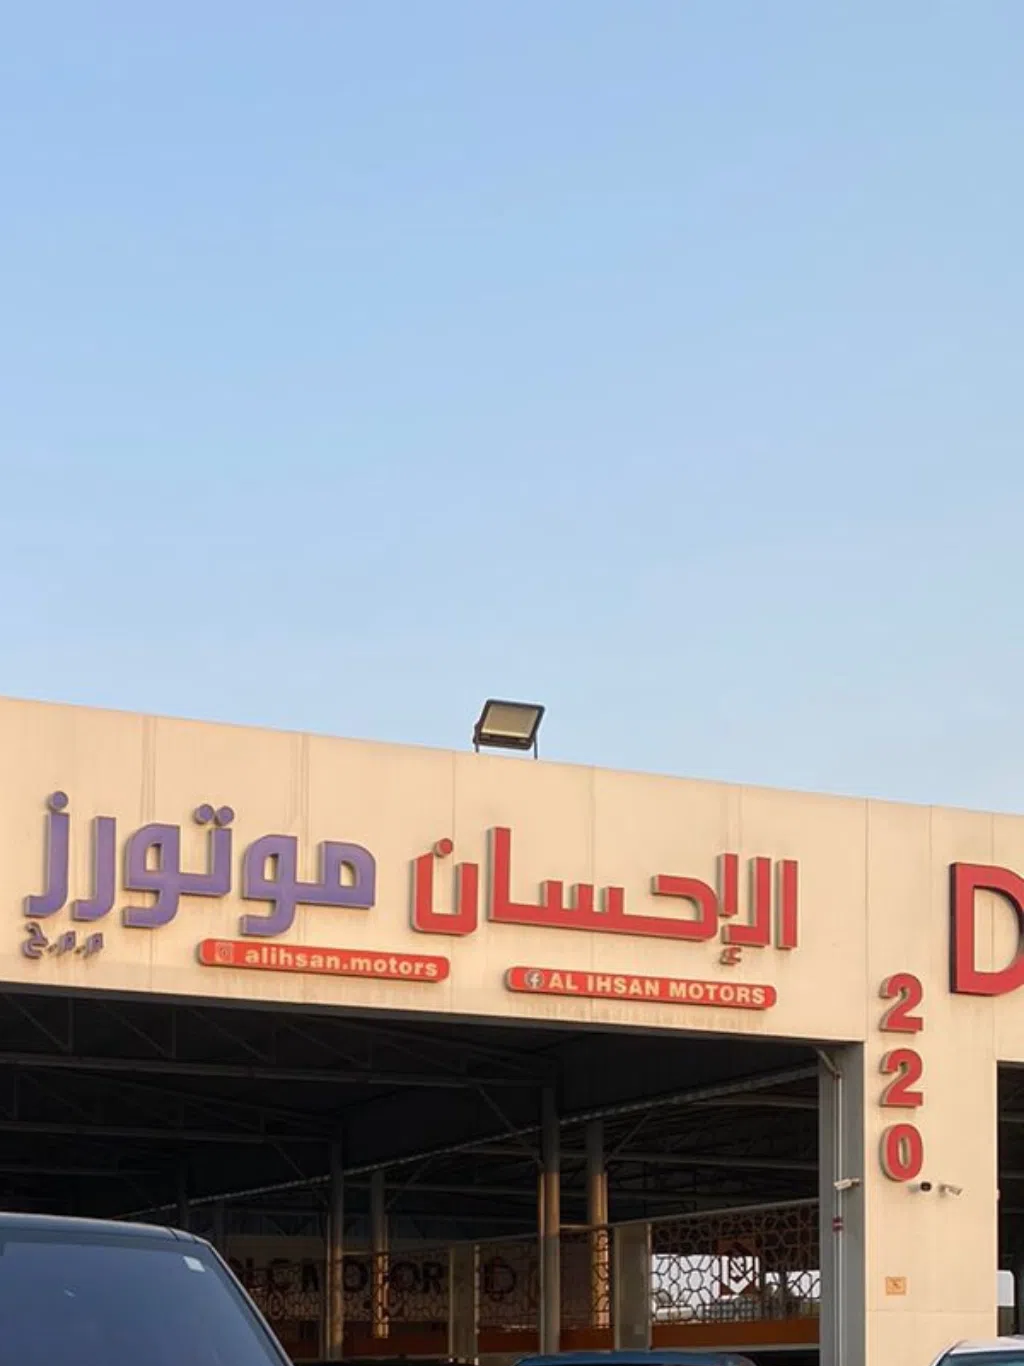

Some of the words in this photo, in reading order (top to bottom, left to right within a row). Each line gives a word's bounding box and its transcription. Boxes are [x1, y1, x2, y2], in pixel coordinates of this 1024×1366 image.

[24, 791, 376, 937] موتورز
[244, 949, 439, 978] alihsan.motors
[548, 972, 579, 991] AL
[586, 974, 662, 999] IHSAN
[668, 982, 767, 1005] MOTORS
